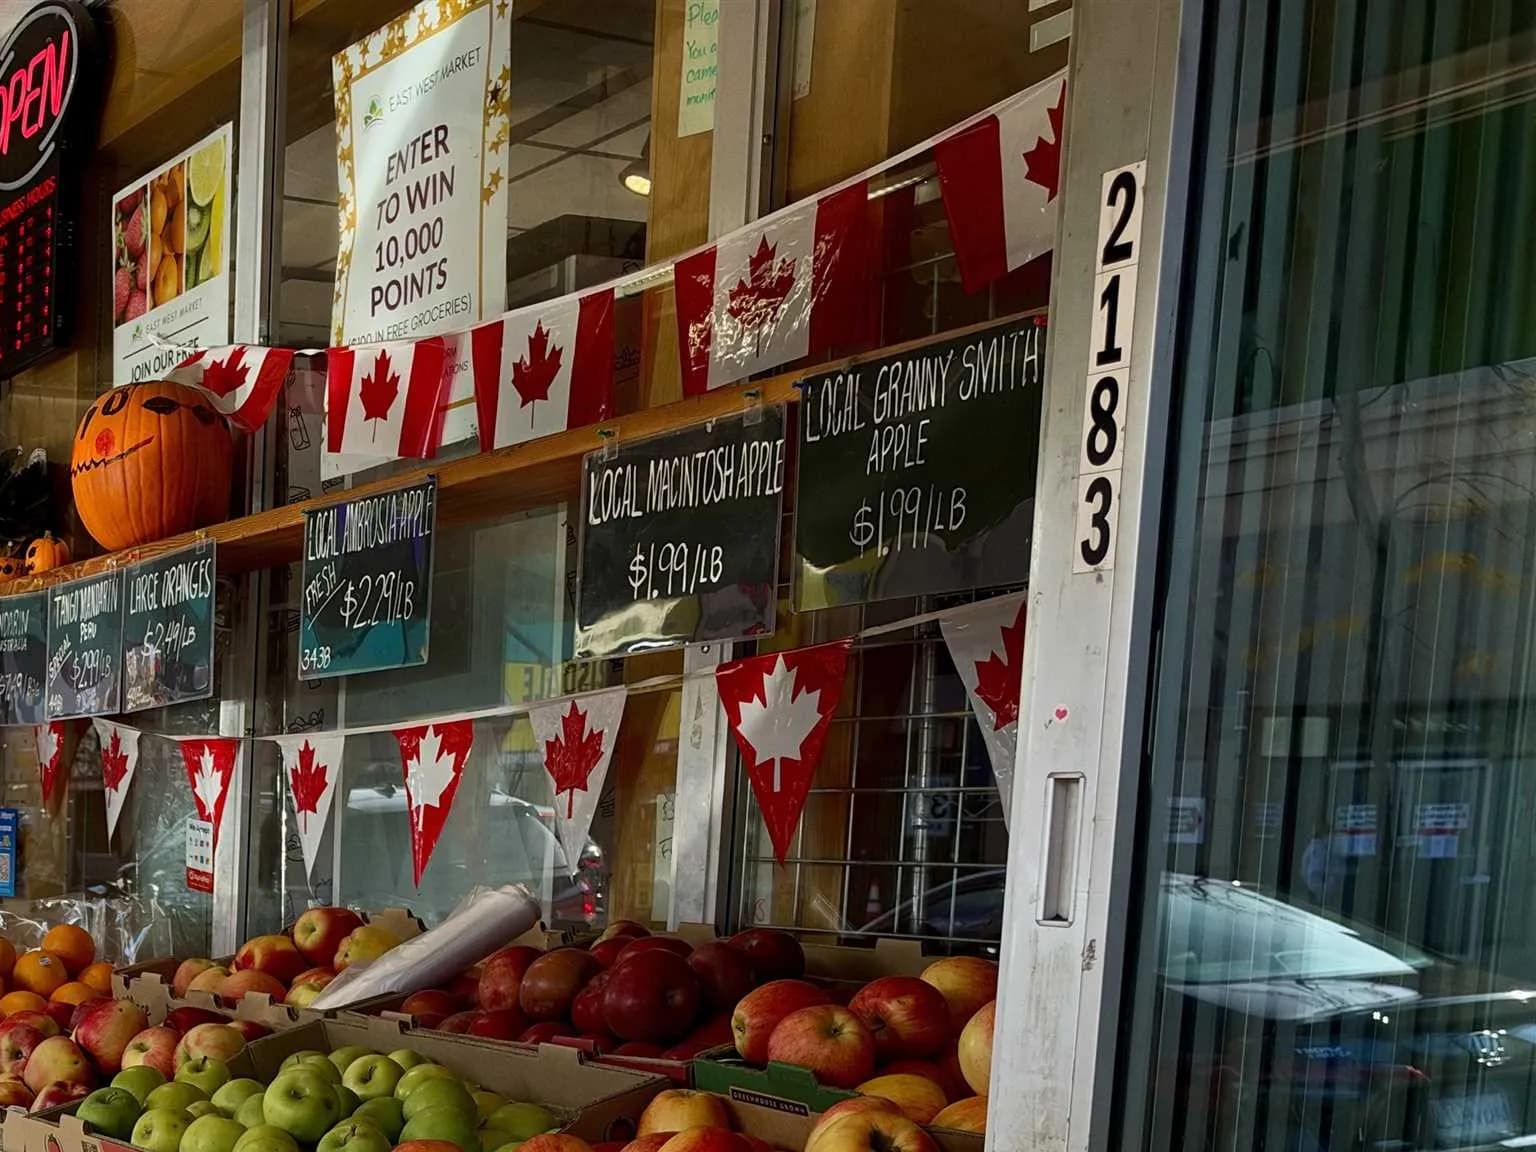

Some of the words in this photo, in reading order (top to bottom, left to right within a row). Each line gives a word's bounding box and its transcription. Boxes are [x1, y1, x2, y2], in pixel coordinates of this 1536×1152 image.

[389, 86, 413, 113] EAST
[414, 70, 442, 99] WEST
[442, 47, 482, 80] MARKET
[385, 124, 450, 186] ENTER
[376, 192, 400, 231] TO
[406, 165, 455, 215] WIN
[375, 217, 443, 273] 10,000
[370, 257, 448, 318] POINTS
[387, 319, 408, 340] FREE
[411, 292, 473, 331] GROCERIES)
[130, 359, 152, 383] JOIN
[153, 350, 174, 373] OUR
[806, 377, 866, 443] LOCAL
[874, 348, 954, 426] GRANNY
[962, 326, 1040, 402] SMITH
[866, 418, 931, 475] APPLE
[589, 464, 643, 526] LOCAL
[648, 444, 734, 512] MACINTOSH
[736, 438, 785, 498] APPLE
[308, 508, 339, 561] LOCAL
[342, 494, 397, 554] AMBROSIA
[399, 485, 435, 541] APPLE
[849, 483, 967, 559] $1.99/LB
[129, 572, 159, 616] LARGE
[161, 557, 212, 609] ORANGES
[305, 561, 337, 616] FRESH
[340, 569, 415, 629] $2.29/LB
[629, 542, 723, 601] $1.99/LB
[301, 646, 331, 671] 3438
